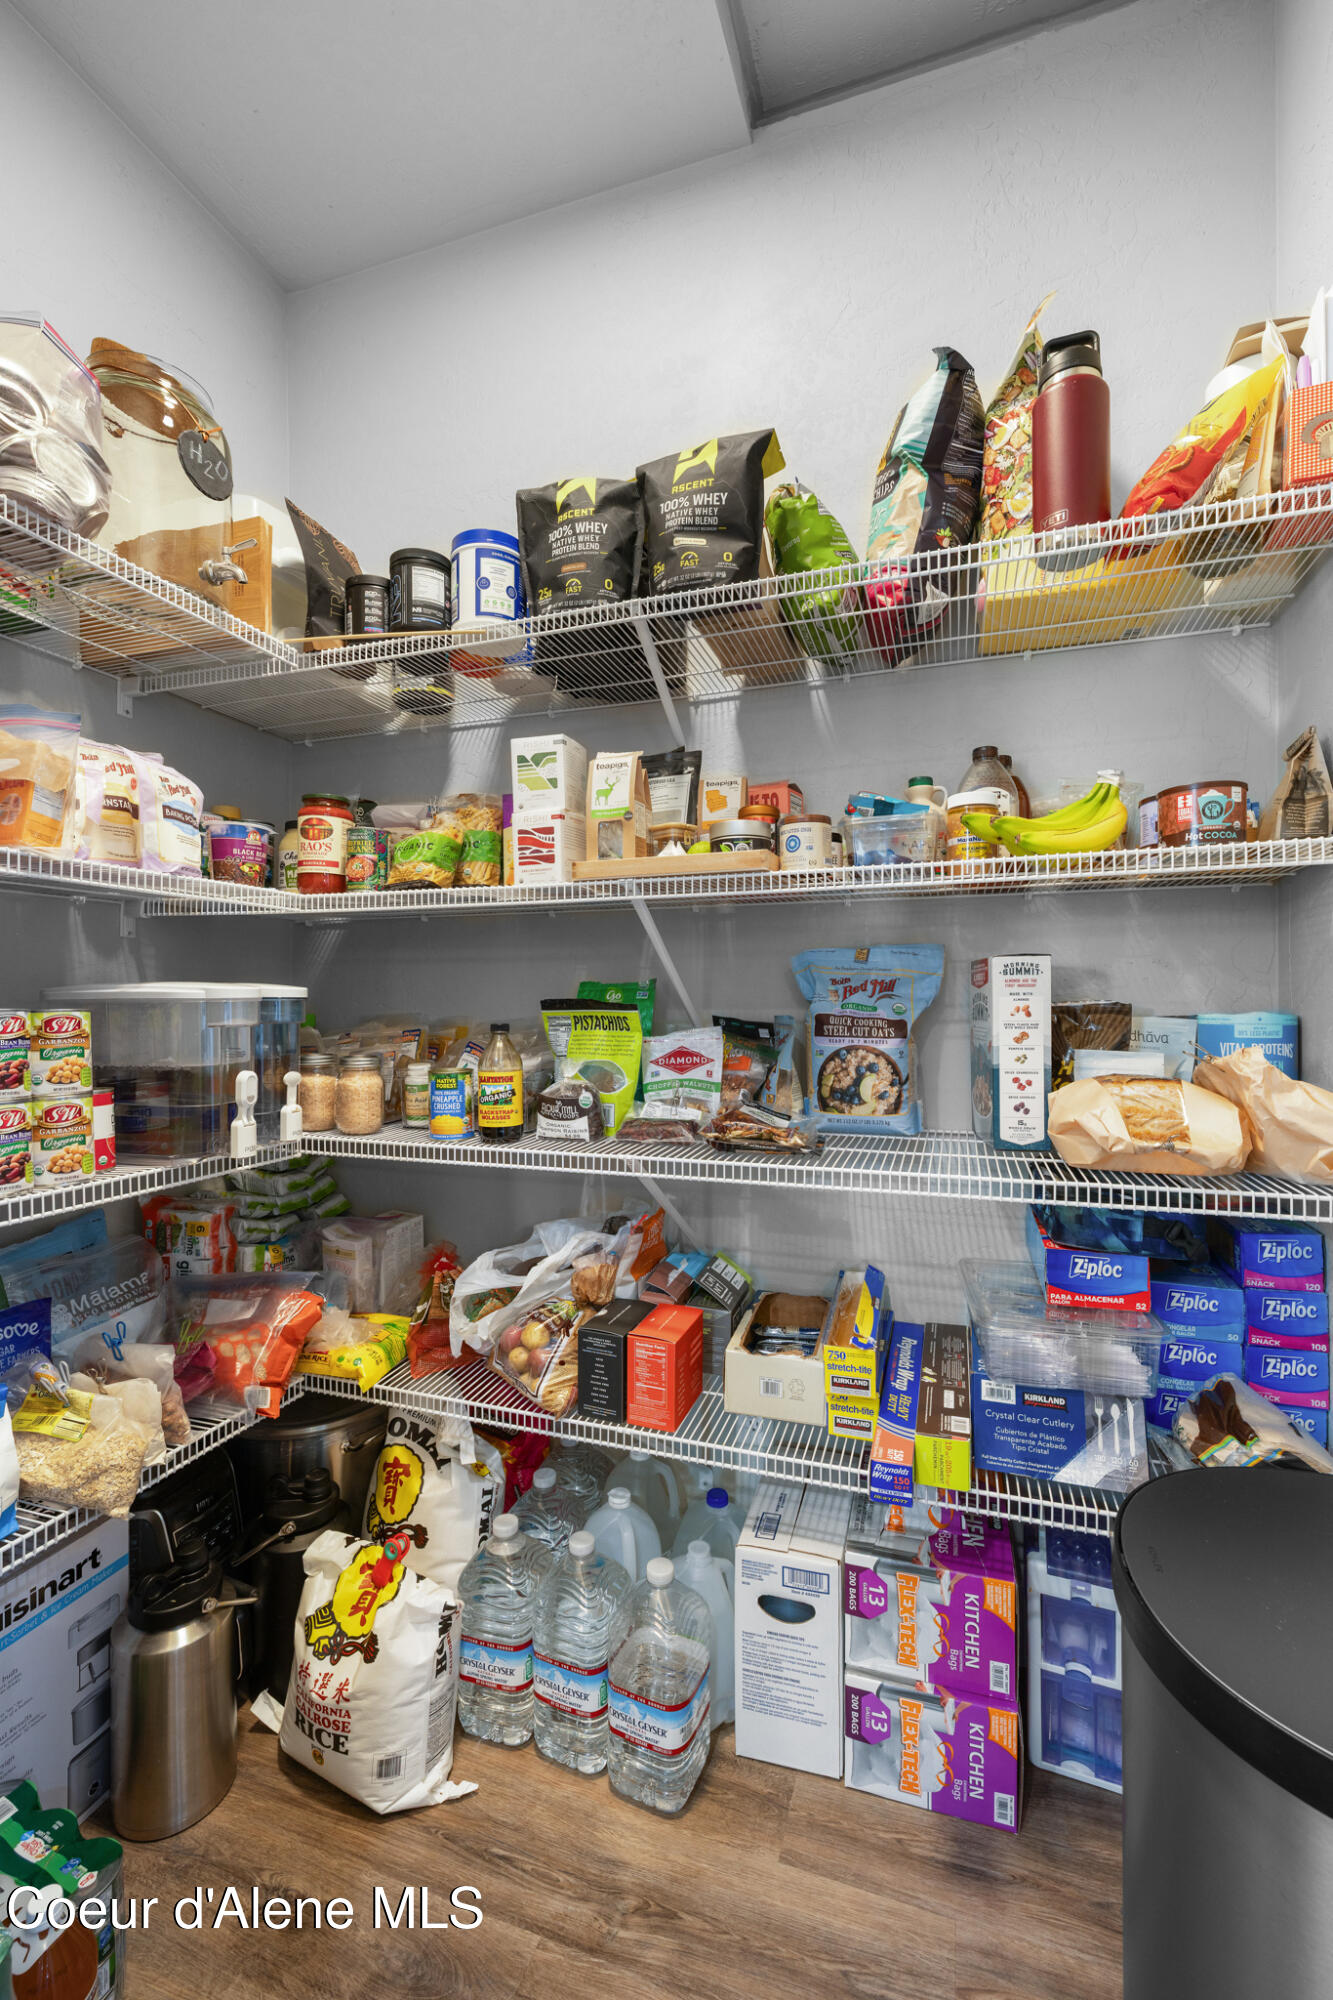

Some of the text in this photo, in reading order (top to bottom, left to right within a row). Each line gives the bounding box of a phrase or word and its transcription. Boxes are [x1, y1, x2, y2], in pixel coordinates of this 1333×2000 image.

[671, 478, 715, 494] ASCENT
[660, 492, 728, 514] 100% WHEY
[557, 507, 596, 524] ASCENT
[665, 507, 719, 520] NATIVE WHEY
[1042, 511, 1066, 528] YETI
[665, 517, 694, 529] PROTEIN
[695, 516, 718, 525] BLEND
[548, 521, 608, 544] 100% WHEY
[552, 534, 600, 549] NATIVE WHEY
[551, 542, 600, 557] PROTEIN BLEND
[680, 558, 699, 567] FAST
[565, 585, 582, 595] FAST
[1204, 831, 1238, 840] COCOA
[232, 847, 254, 856] BLACK
[300, 841, 332, 852] RAO'S
[1002, 967, 1040, 976] SUMMIT
[842, 979, 868, 1002] Red
[868, 978, 897, 998] Mill
[573, 1014, 631, 1032] PISTACHIOS
[829, 1016, 888, 1028] QUICK COOKING
[823, 1025, 895, 1038] STEEL CUT OATS
[38, 1037, 86, 1046] GARBANZOS
[42, 1047, 84, 1060] Organic
[658, 1056, 708, 1065] DIAMOND
[432, 1095, 463, 1103] PINEAPPLE
[480, 1090, 513, 1103] ORGANIC
[433, 1102, 461, 1110] CRUSHED
[39, 1125, 87, 1136] GARBANZOS
[43, 1135, 85, 1149] Organic
[1262, 1242, 1312, 1264] Ziploc
[1073, 1258, 1123, 1280] Ziploc
[1246, 1279, 1321, 1291] SNACK 120
[1050, 1293, 1125, 1305] PARA ALMACENAR
[1170, 1291, 1220, 1313] Ziploc
[1135, 1303, 1147, 1311] 52
[1265, 1300, 1317, 1322] Ziploc
[1227, 1334, 1239, 1342] 50
[1251, 1338, 1327, 1352] SNACK 108
[827, 1350, 847, 1361] 750
[1168, 1344, 1217, 1366] Ziploc
[826, 1362, 873, 1375] stretch-tite
[890, 1336, 918, 1391] Reynolds Wrap
[1265, 1357, 1318, 1380] Ziploc
[832, 1377, 869, 1387] KIRKLAND
[887, 1393, 899, 1415] DUTY
[1024, 1392, 1067, 1405] KIRKLAND
[1310, 1399, 1327, 1408] 108
[830, 1402, 876, 1417] stretch-tite
[897, 1393, 913, 1422] HEAVY
[836, 1417, 871, 1428] KIRKLAND
[985, 1408, 1075, 1432] Crystal Clear Cutlery
[993, 1433, 1068, 1451] Transparente Acabado
[995, 1426, 1065, 1443] Cubiertos de Plástico
[1011, 1442, 1050, 1456] Tipo Cristal
[871, 1470, 893, 1482] Wrap
[874, 1463, 910, 1476] Reynolds
[893, 1476, 911, 1486] 150
[478, 1487, 494, 1549] OMAI
[848, 1571, 857, 1612] 200 BAGS
[868, 1585, 885, 1607] 13
[895, 1571, 921, 1669] FLEX-TECH
[964, 1592, 981, 1670] KITCHEN
[460, 1657, 517, 1677] CRYSTAL GEYSER
[950, 1648, 959, 1671] Bags
[535, 1675, 590, 1702] CRYSTAL GEYSER
[296, 1684, 352, 1719] CALIFORNIA
[296, 1695, 351, 1734] CALROSE
[609, 1705, 667, 1738] CRYSTAL GEYSER
[850, 1693, 859, 1736] 200 BAGS
[871, 1711, 888, 1734] 13
[294, 1706, 350, 1756] RICE
[899, 1697, 924, 1798] FLEX-TECH
[968, 1722, 985, 1800] KITCHEN
[952, 1778, 963, 1801] Bags
